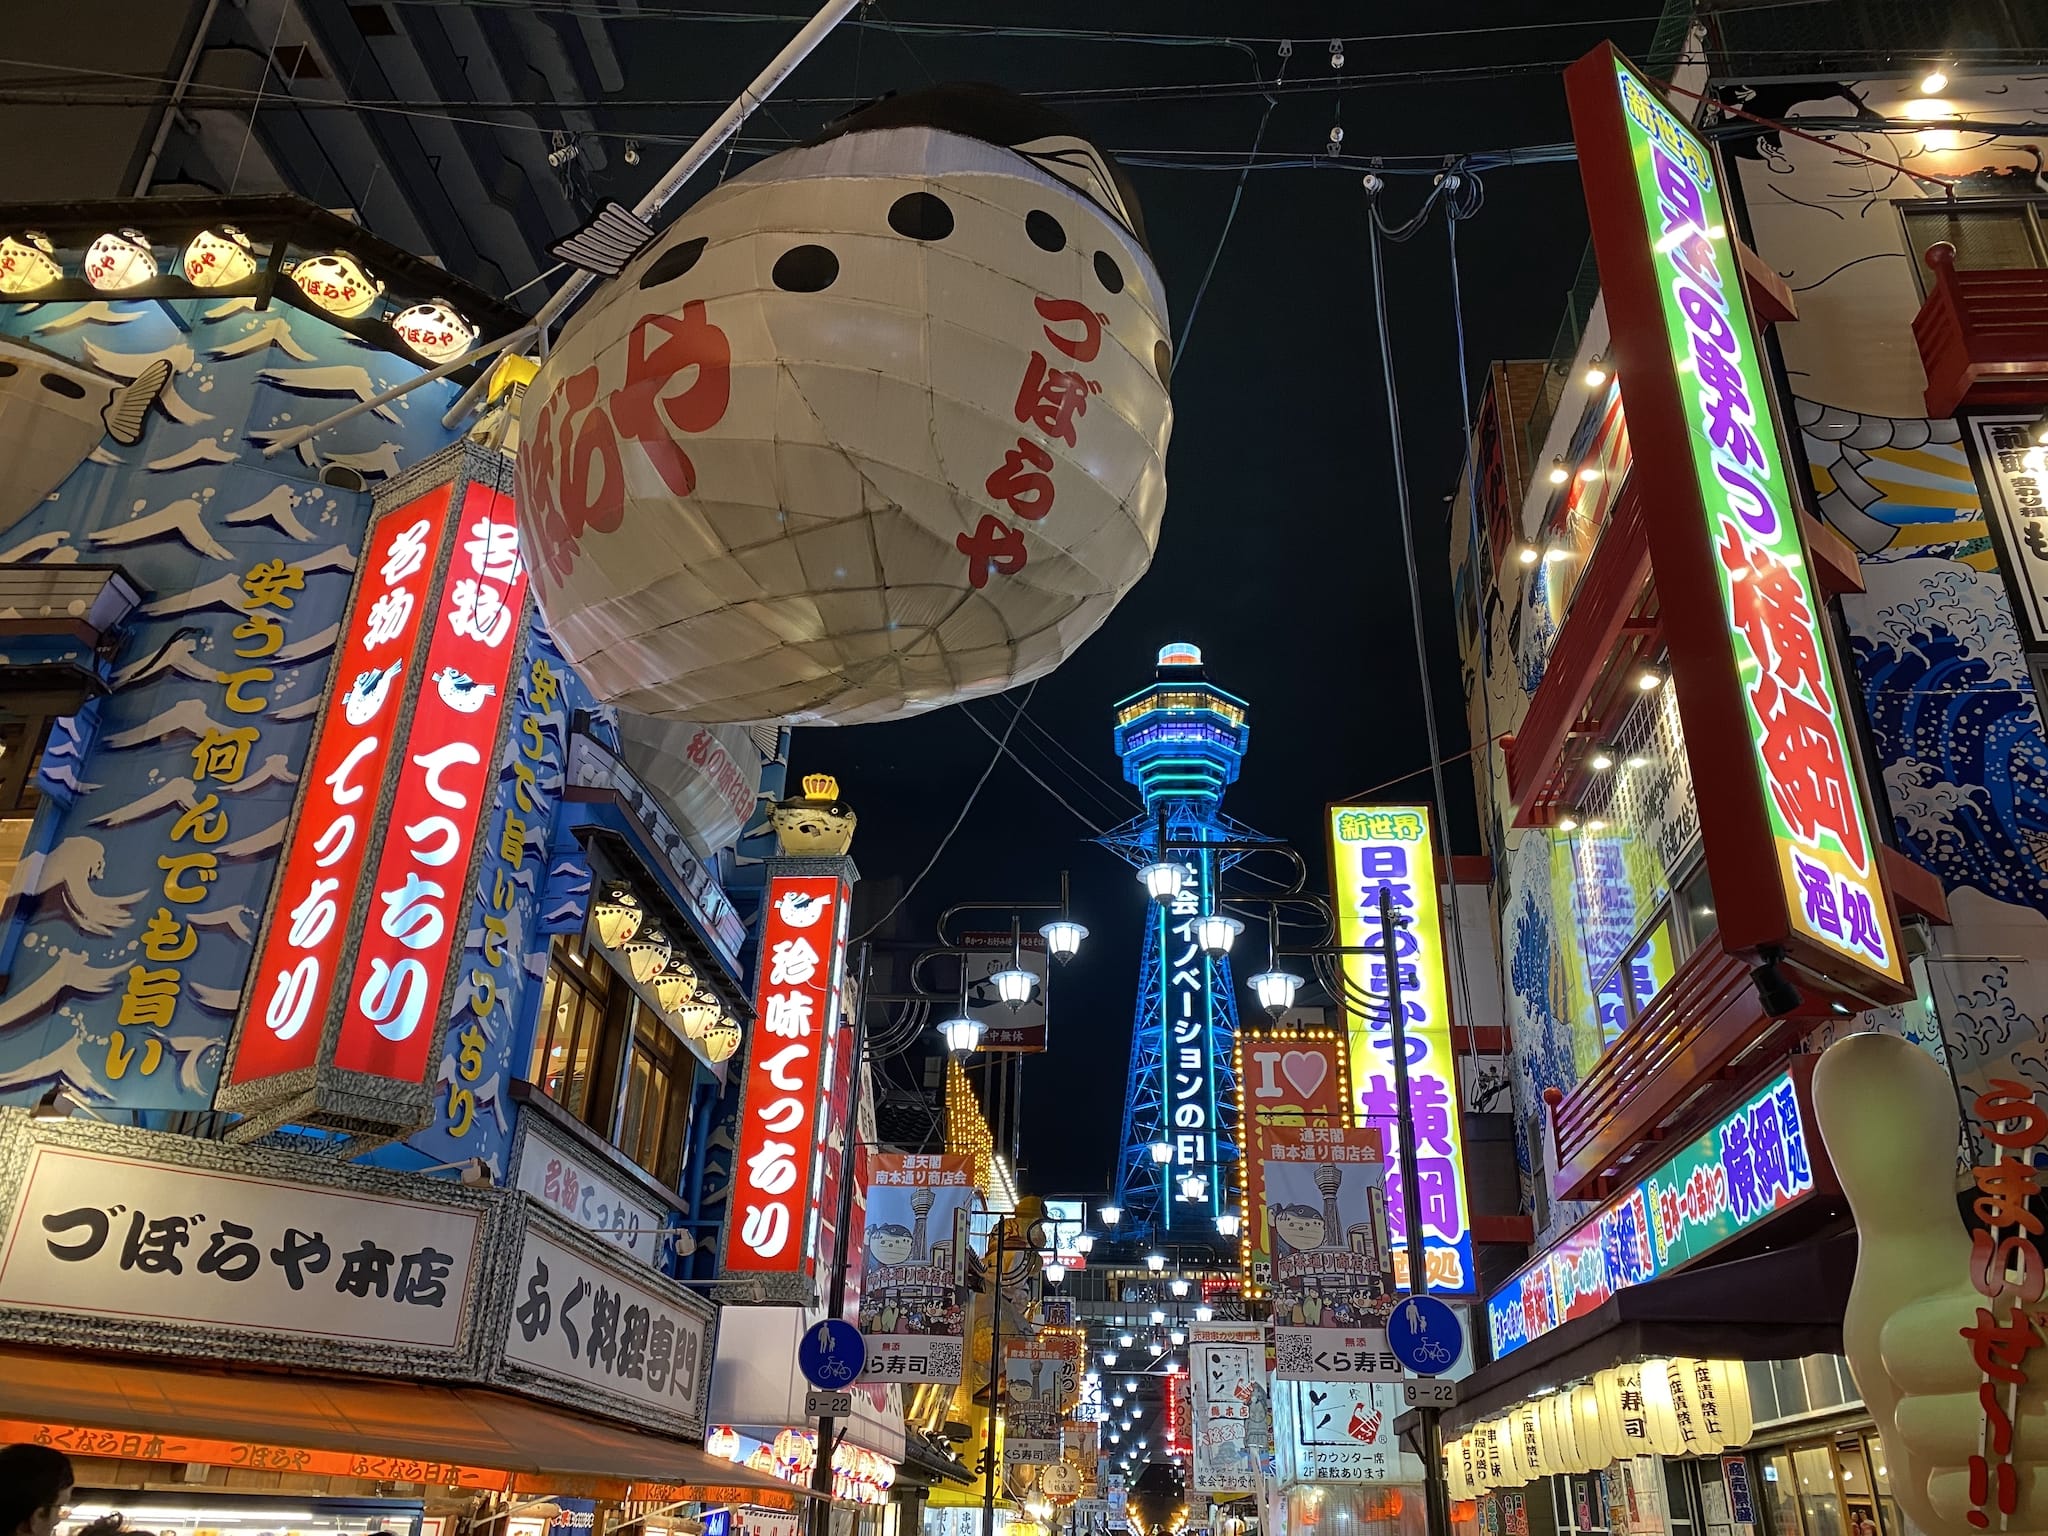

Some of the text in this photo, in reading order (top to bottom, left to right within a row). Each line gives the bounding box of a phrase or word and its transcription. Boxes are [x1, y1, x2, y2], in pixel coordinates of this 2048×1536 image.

[1623, 74, 1712, 190] 新世界
[956, 296, 1110, 588] づぼらや
[363, 519, 431, 651] 名物
[451, 517, 522, 648] 名物
[1716, 520, 1869, 873] 横綱
[105, 558, 305, 1080] 安うて何んでも旨い
[1340, 812, 1423, 842] 新世界
[1796, 852, 1887, 966] 酒処
[875, 1170, 968, 1185] 南本通り商店会
[902, 1154, 943, 1169] 通天閣
[1271, 1144, 1377, 1162] 南本通り商店会
[1300, 1127, 1345, 1144] 通天閣
[1721, 1097, 1790, 1222] 横綱
[1776, 1083, 1810, 1188] 酒処
[41, 1202, 455, 1308] づぼらや本店
[515, 1255, 698, 1402] ふぐ料理専門
[1314, 1350, 1401, 1374] くら寿司
[33, 1426, 188, 1460] ふぐなら日本一
[1317, 1452, 1386, 1465] カウンター席
[1621, 1390, 1647, 1439] 寿司
[1317, 1466, 1387, 1480] 座敷あります
